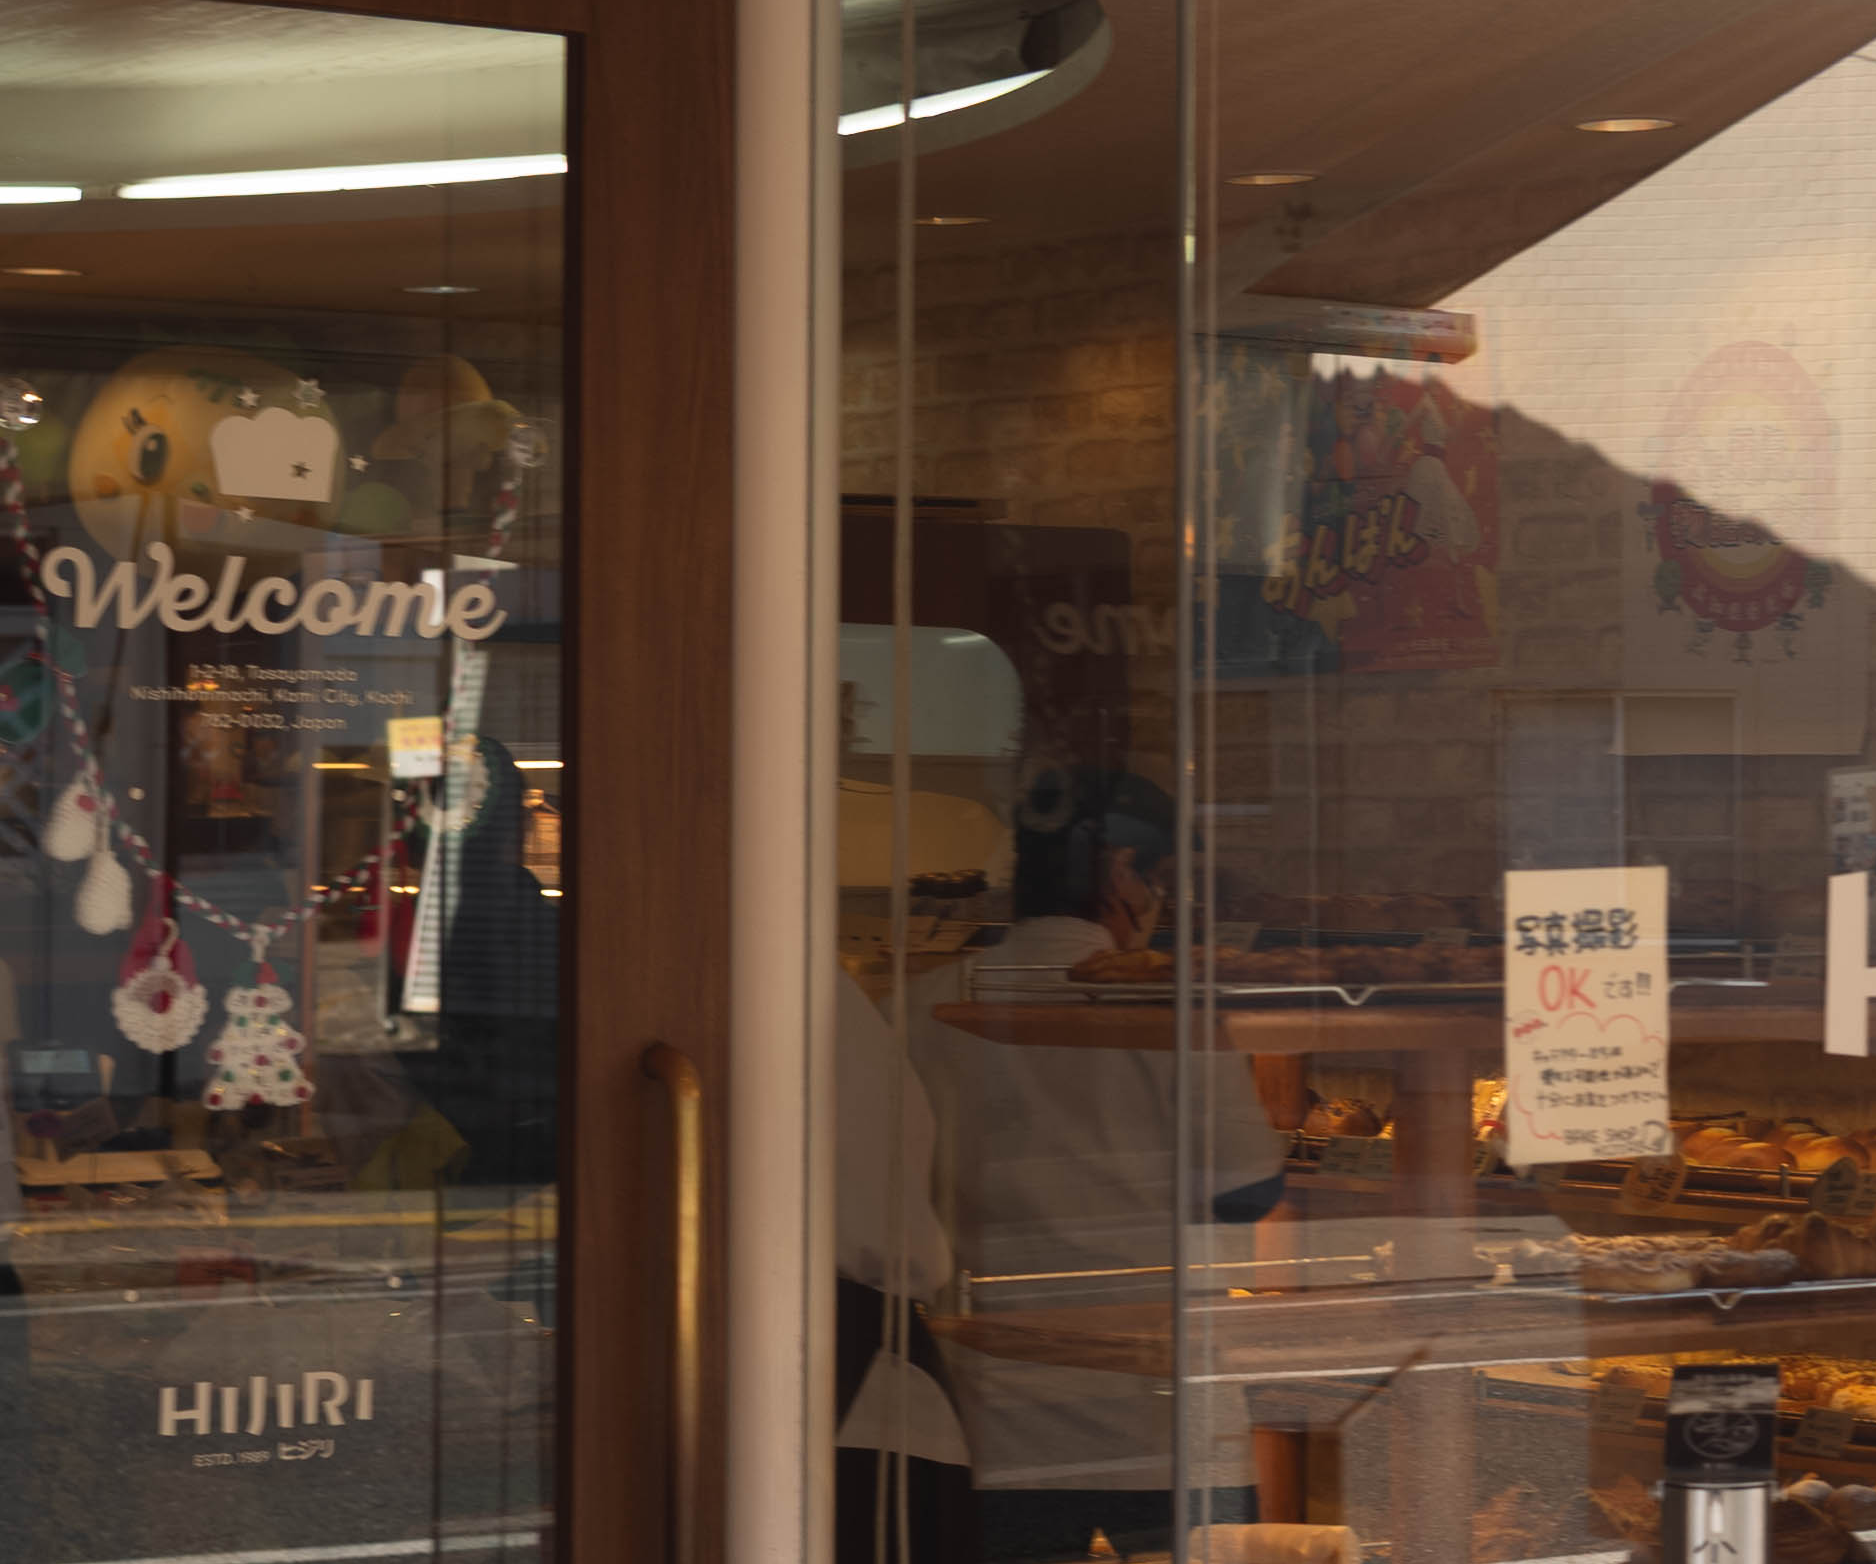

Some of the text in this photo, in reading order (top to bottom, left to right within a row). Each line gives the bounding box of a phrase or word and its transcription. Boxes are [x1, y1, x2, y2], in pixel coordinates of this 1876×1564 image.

[40, 540, 508, 641] Welcome
[1537, 964, 1598, 1013] OK
[277, 1439, 336, 1461] ヒジリ
